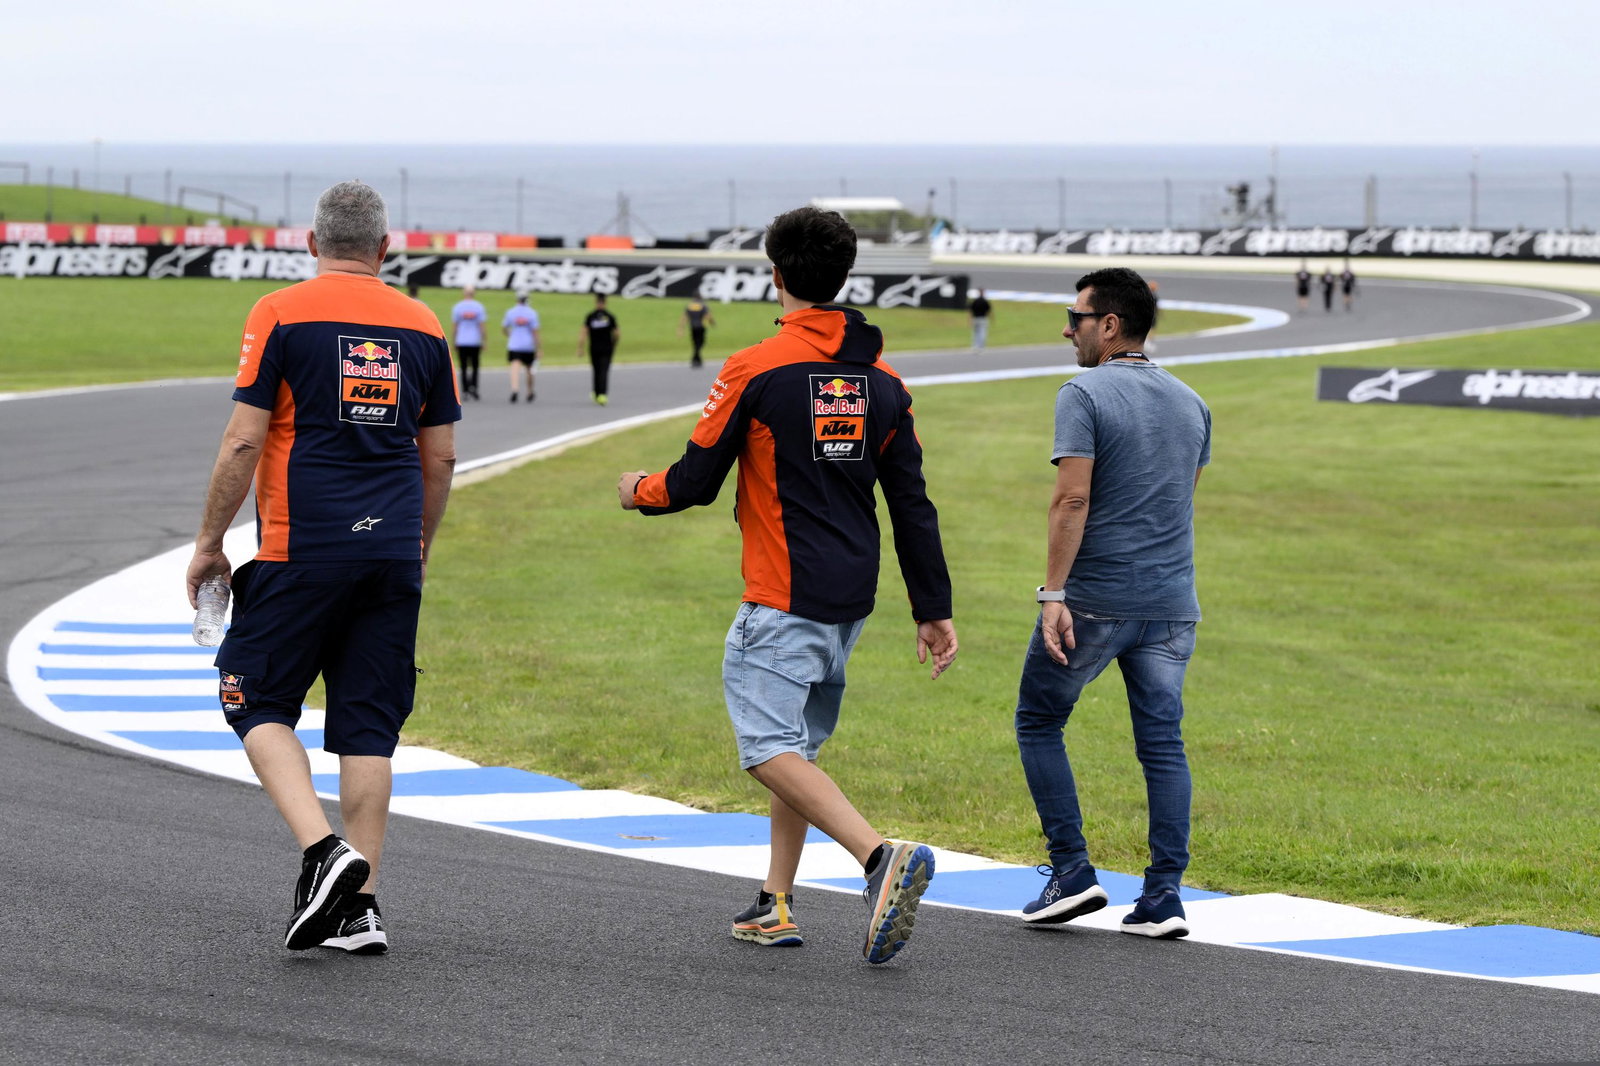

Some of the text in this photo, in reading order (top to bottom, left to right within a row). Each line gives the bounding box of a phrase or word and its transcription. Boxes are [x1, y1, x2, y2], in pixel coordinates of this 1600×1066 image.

[0, 240, 148, 279] alpinestars
[440, 254, 619, 294] alpinestars
[343, 360, 398, 379] Red Bull
[350, 384, 390, 400] KTM
[350, 406, 388, 415] AJO
[814, 398, 866, 415] Red Bull
[821, 421, 857, 436] KTM
[823, 443, 854, 452] AJO
